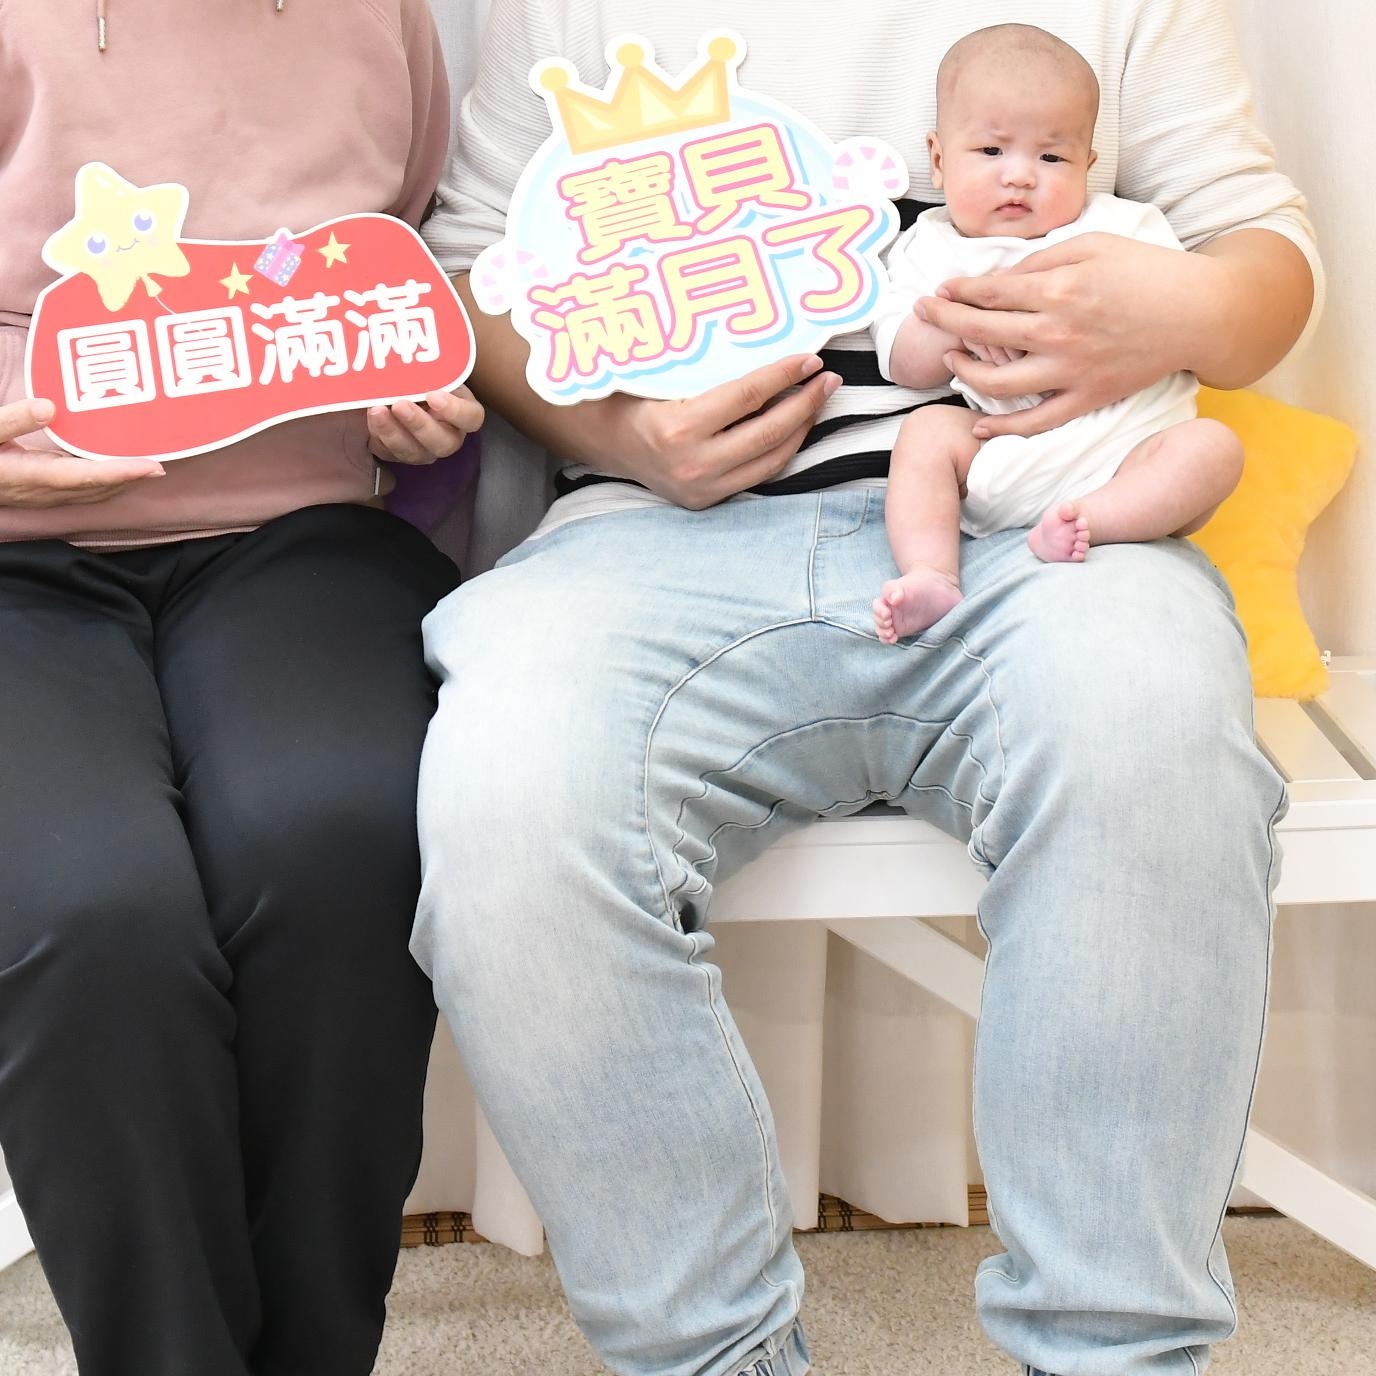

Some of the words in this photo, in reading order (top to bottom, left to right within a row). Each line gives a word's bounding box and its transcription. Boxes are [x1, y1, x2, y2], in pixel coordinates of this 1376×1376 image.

[556, 122, 812, 266] 寶貝
[56, 278, 441, 414] 圓圓滿滿
[526, 204, 875, 383] 滿月了
